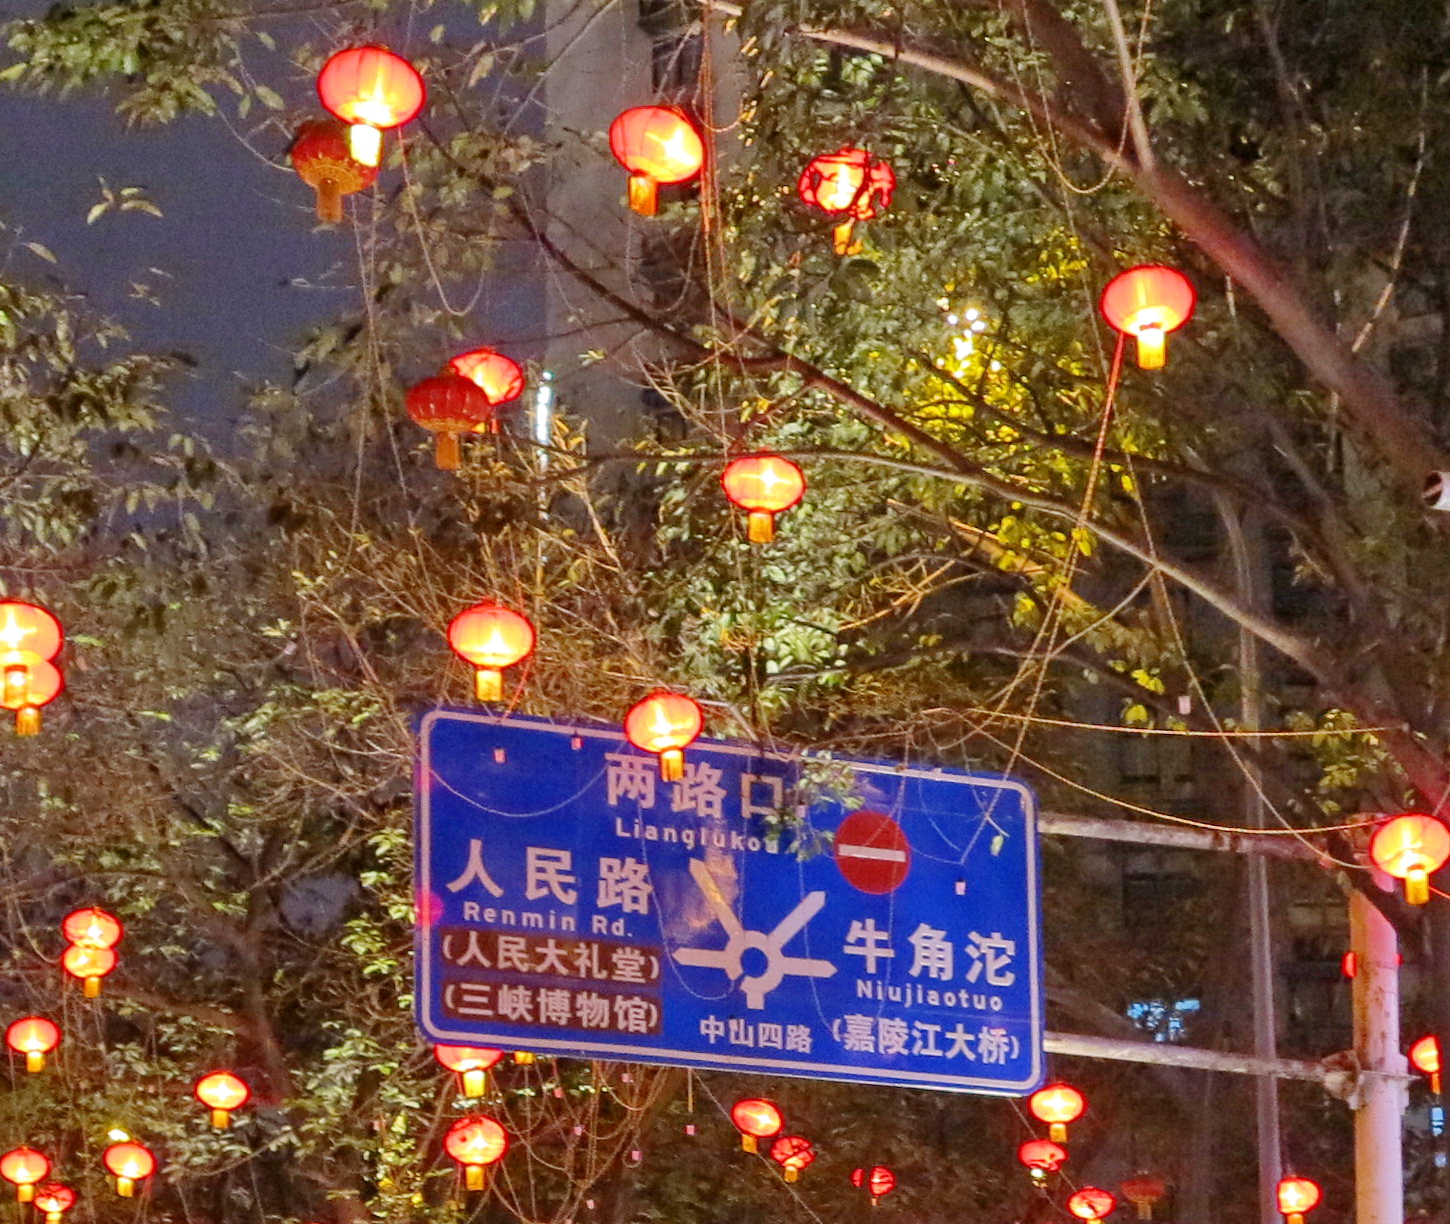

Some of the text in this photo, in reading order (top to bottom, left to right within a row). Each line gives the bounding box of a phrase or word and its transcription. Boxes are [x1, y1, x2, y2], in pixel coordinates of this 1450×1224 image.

[605, 752, 784, 819] 两路口
[615, 817, 779, 854] Lianglukou
[446, 838, 653, 915] 人民路
[463, 901, 633, 937] Renmin Rd.
[442, 930, 659, 984] (人民大礼堂)
[843, 918, 1015, 987] 牛角沱
[444, 982, 658, 1034] (三峡博物馆)
[856, 979, 1003, 1021] Niujiaotuo
[699, 1014, 813, 1054] 中山四路
[833, 1013, 1020, 1065] (嘉陵江大桥)
